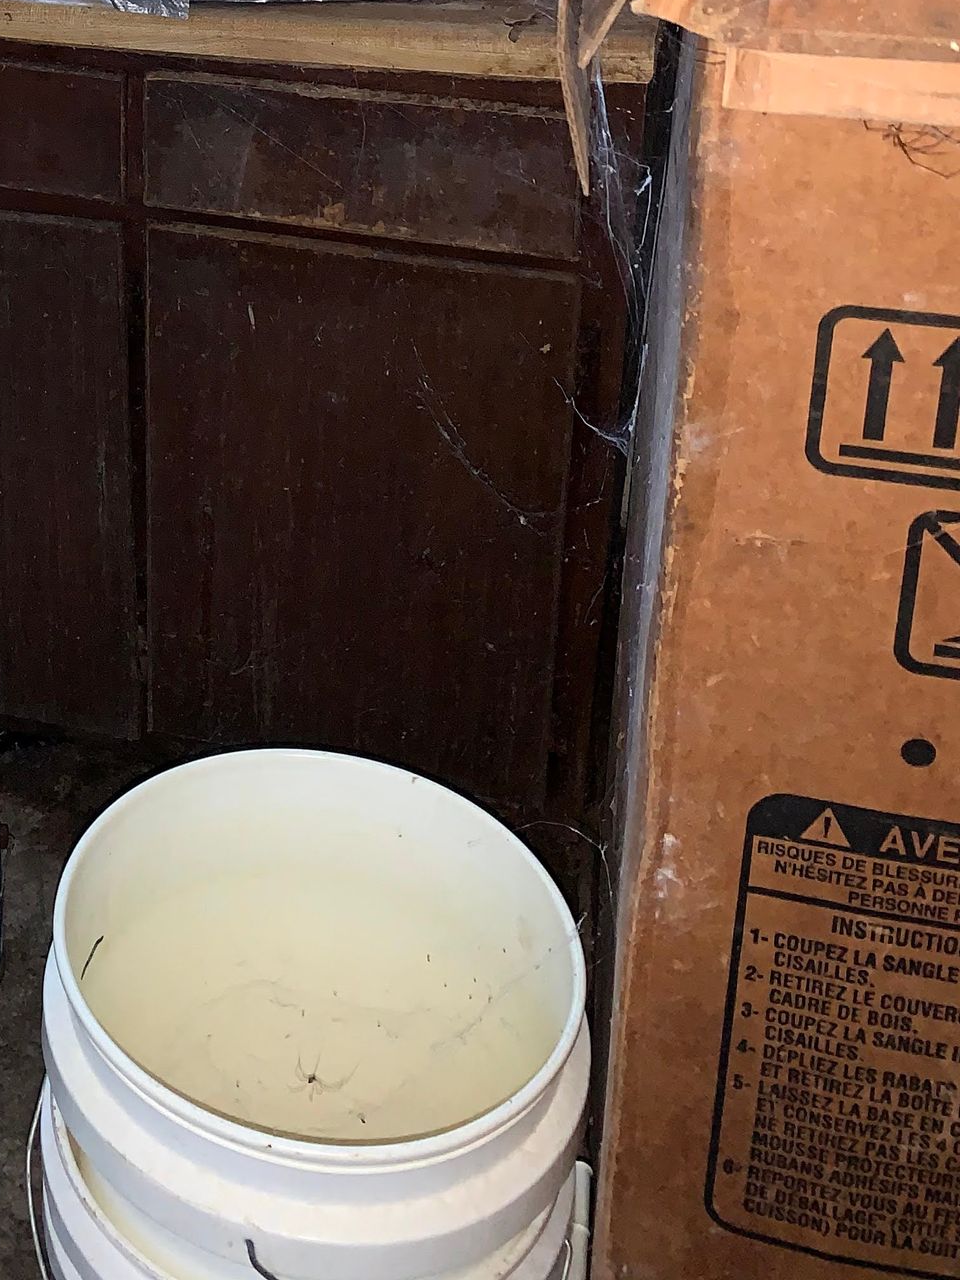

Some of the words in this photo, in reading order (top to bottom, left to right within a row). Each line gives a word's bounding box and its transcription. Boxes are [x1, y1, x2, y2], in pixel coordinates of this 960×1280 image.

[757, 840, 837, 868] RISQUES
[841, 856, 867, 874] DE
[872, 862, 960, 889] BLESSUR
[774, 859, 868, 891] N'HÉSITEZ
[871, 878, 909, 897] PAS
[932, 888, 960, 906] DE
[848, 891, 949, 921] PERSONNE
[773, 932, 849, 964] COUPEZ
[853, 949, 877, 970] LA
[883, 954, 960, 985] SANGLE
[773, 950, 876, 988] CISAILLES.
[769, 969, 848, 1002] RETIREZ
[853, 988, 876, 1007] LE
[880, 993, 960, 1024] COUVER
[769, 988, 832, 1017] CADRE
[837, 1004, 862, 1024] DE
[867, 1009, 920, 1035] BOIS.
[764, 1024, 865, 1062] CISAILLES.
[765, 1006, 839, 1039] COUPEZ
[843, 1025, 867, 1046] LA
[872, 1030, 949, 1061] SANGLE
[760, 1060, 783, 1080] ET
[787, 1067, 865, 1100] RETIREZ
[869, 1086, 892, 1105] LA
[763, 1043, 839, 1077] DÉPLIEZ
[843, 1063, 878, 1085] LES
[757, 1079, 835, 1110] LAISSEZ
[839, 1100, 862, 1120] LA
[866, 1104, 915, 1130] BASE
[919, 1114, 945, 1135] EN
[757, 1096, 776, 1113] ET
[783, 1102, 892, 1141] CONSERVEZ
[896, 1128, 931, 1151] LES
[750, 1146, 824, 1180] RUBANS
[751, 1130, 829, 1163] MOUSSE
[754, 1113, 779, 1133] NE
[783, 1120, 860, 1153] RETIREZ
[864, 1140, 901, 1162] PAS
[906, 1148, 940, 1170] LES
[835, 1221, 886, 1246] POUR
[902, 1201, 928, 1220] AU
